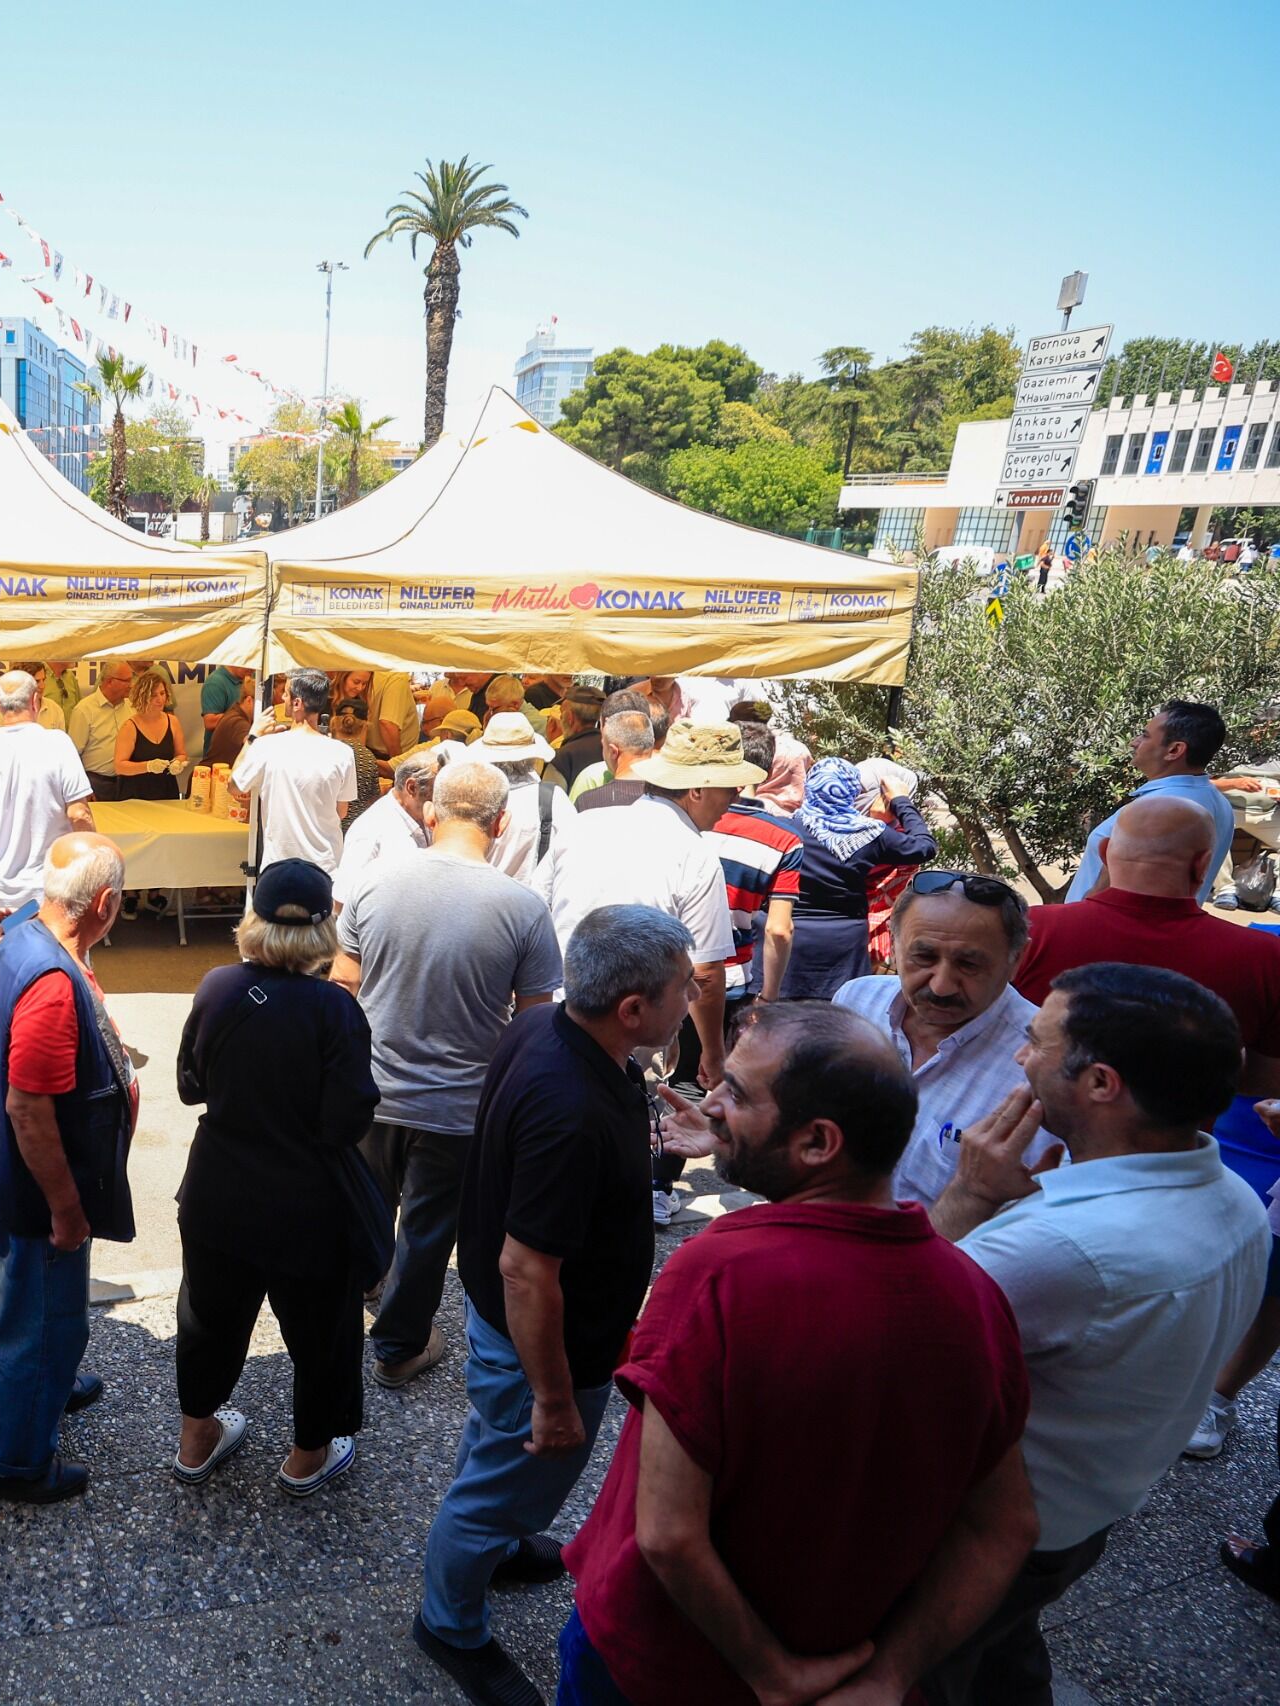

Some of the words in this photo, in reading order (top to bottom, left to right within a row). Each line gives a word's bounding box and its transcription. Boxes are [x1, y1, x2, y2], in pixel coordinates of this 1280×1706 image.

[1032, 336, 1080, 351] Bornova
[1029, 349, 1086, 366] Karşıyaka
[1023, 375, 1078, 389] Gaziemir
[1024, 391, 1083, 403] Havalimanı
[1015, 416, 1061, 427] Ankara
[1007, 449, 1061, 466] Çevreyolu
[1005, 467, 1052, 480] Otogar
[186, 580, 240, 593] KONAK
[106, 592, 139, 601] MUTLU
[329, 587, 384, 600] KONAK
[491, 583, 570, 613] Mutlu
[596, 589, 686, 611] KONAK
[329, 601, 384, 610] BELEDİYESİ
[440, 601, 475, 610] MUTLU
[830, 594, 887, 607] KONAK
[744, 606, 780, 615] MUTLU
